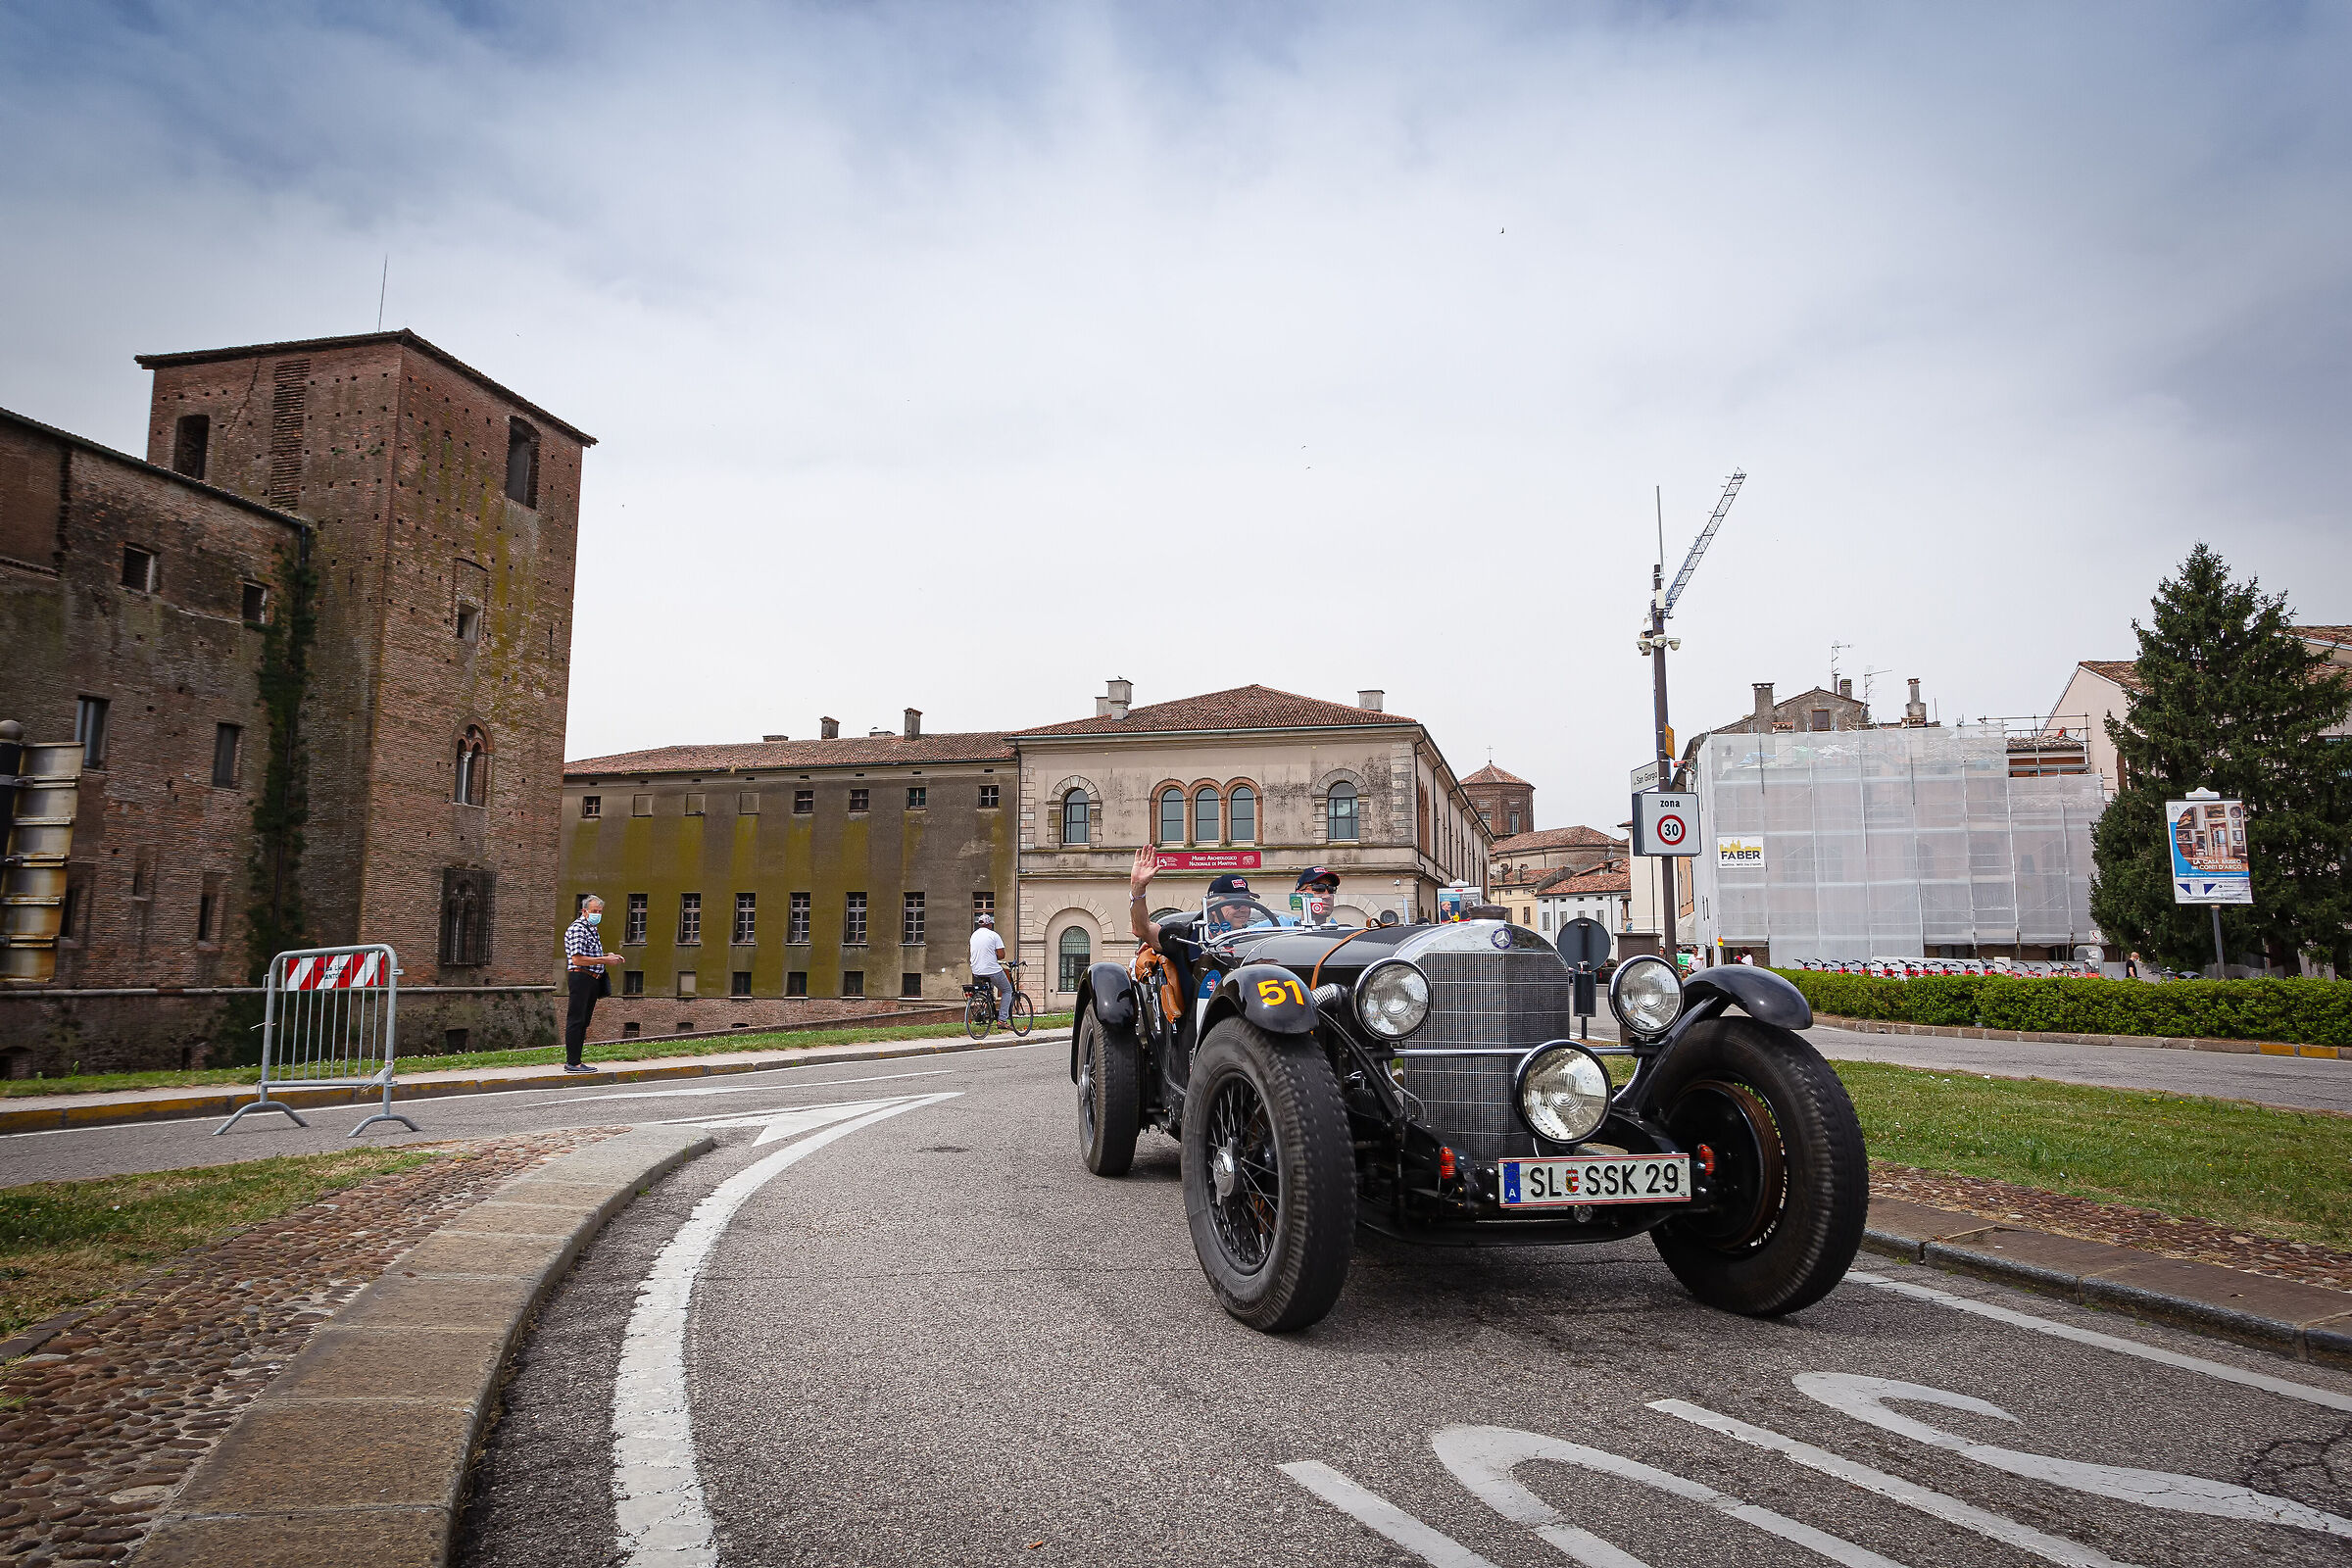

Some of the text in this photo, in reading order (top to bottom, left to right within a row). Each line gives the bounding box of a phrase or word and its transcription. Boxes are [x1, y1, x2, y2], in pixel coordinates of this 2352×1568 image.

[1664, 824, 1679, 836] 30
[1721, 850, 1761, 860] FABER
[1257, 979, 1305, 1006] 51
[1529, 1162, 1679, 1198] SL SSK 29
[1508, 1188, 1517, 1198] A
